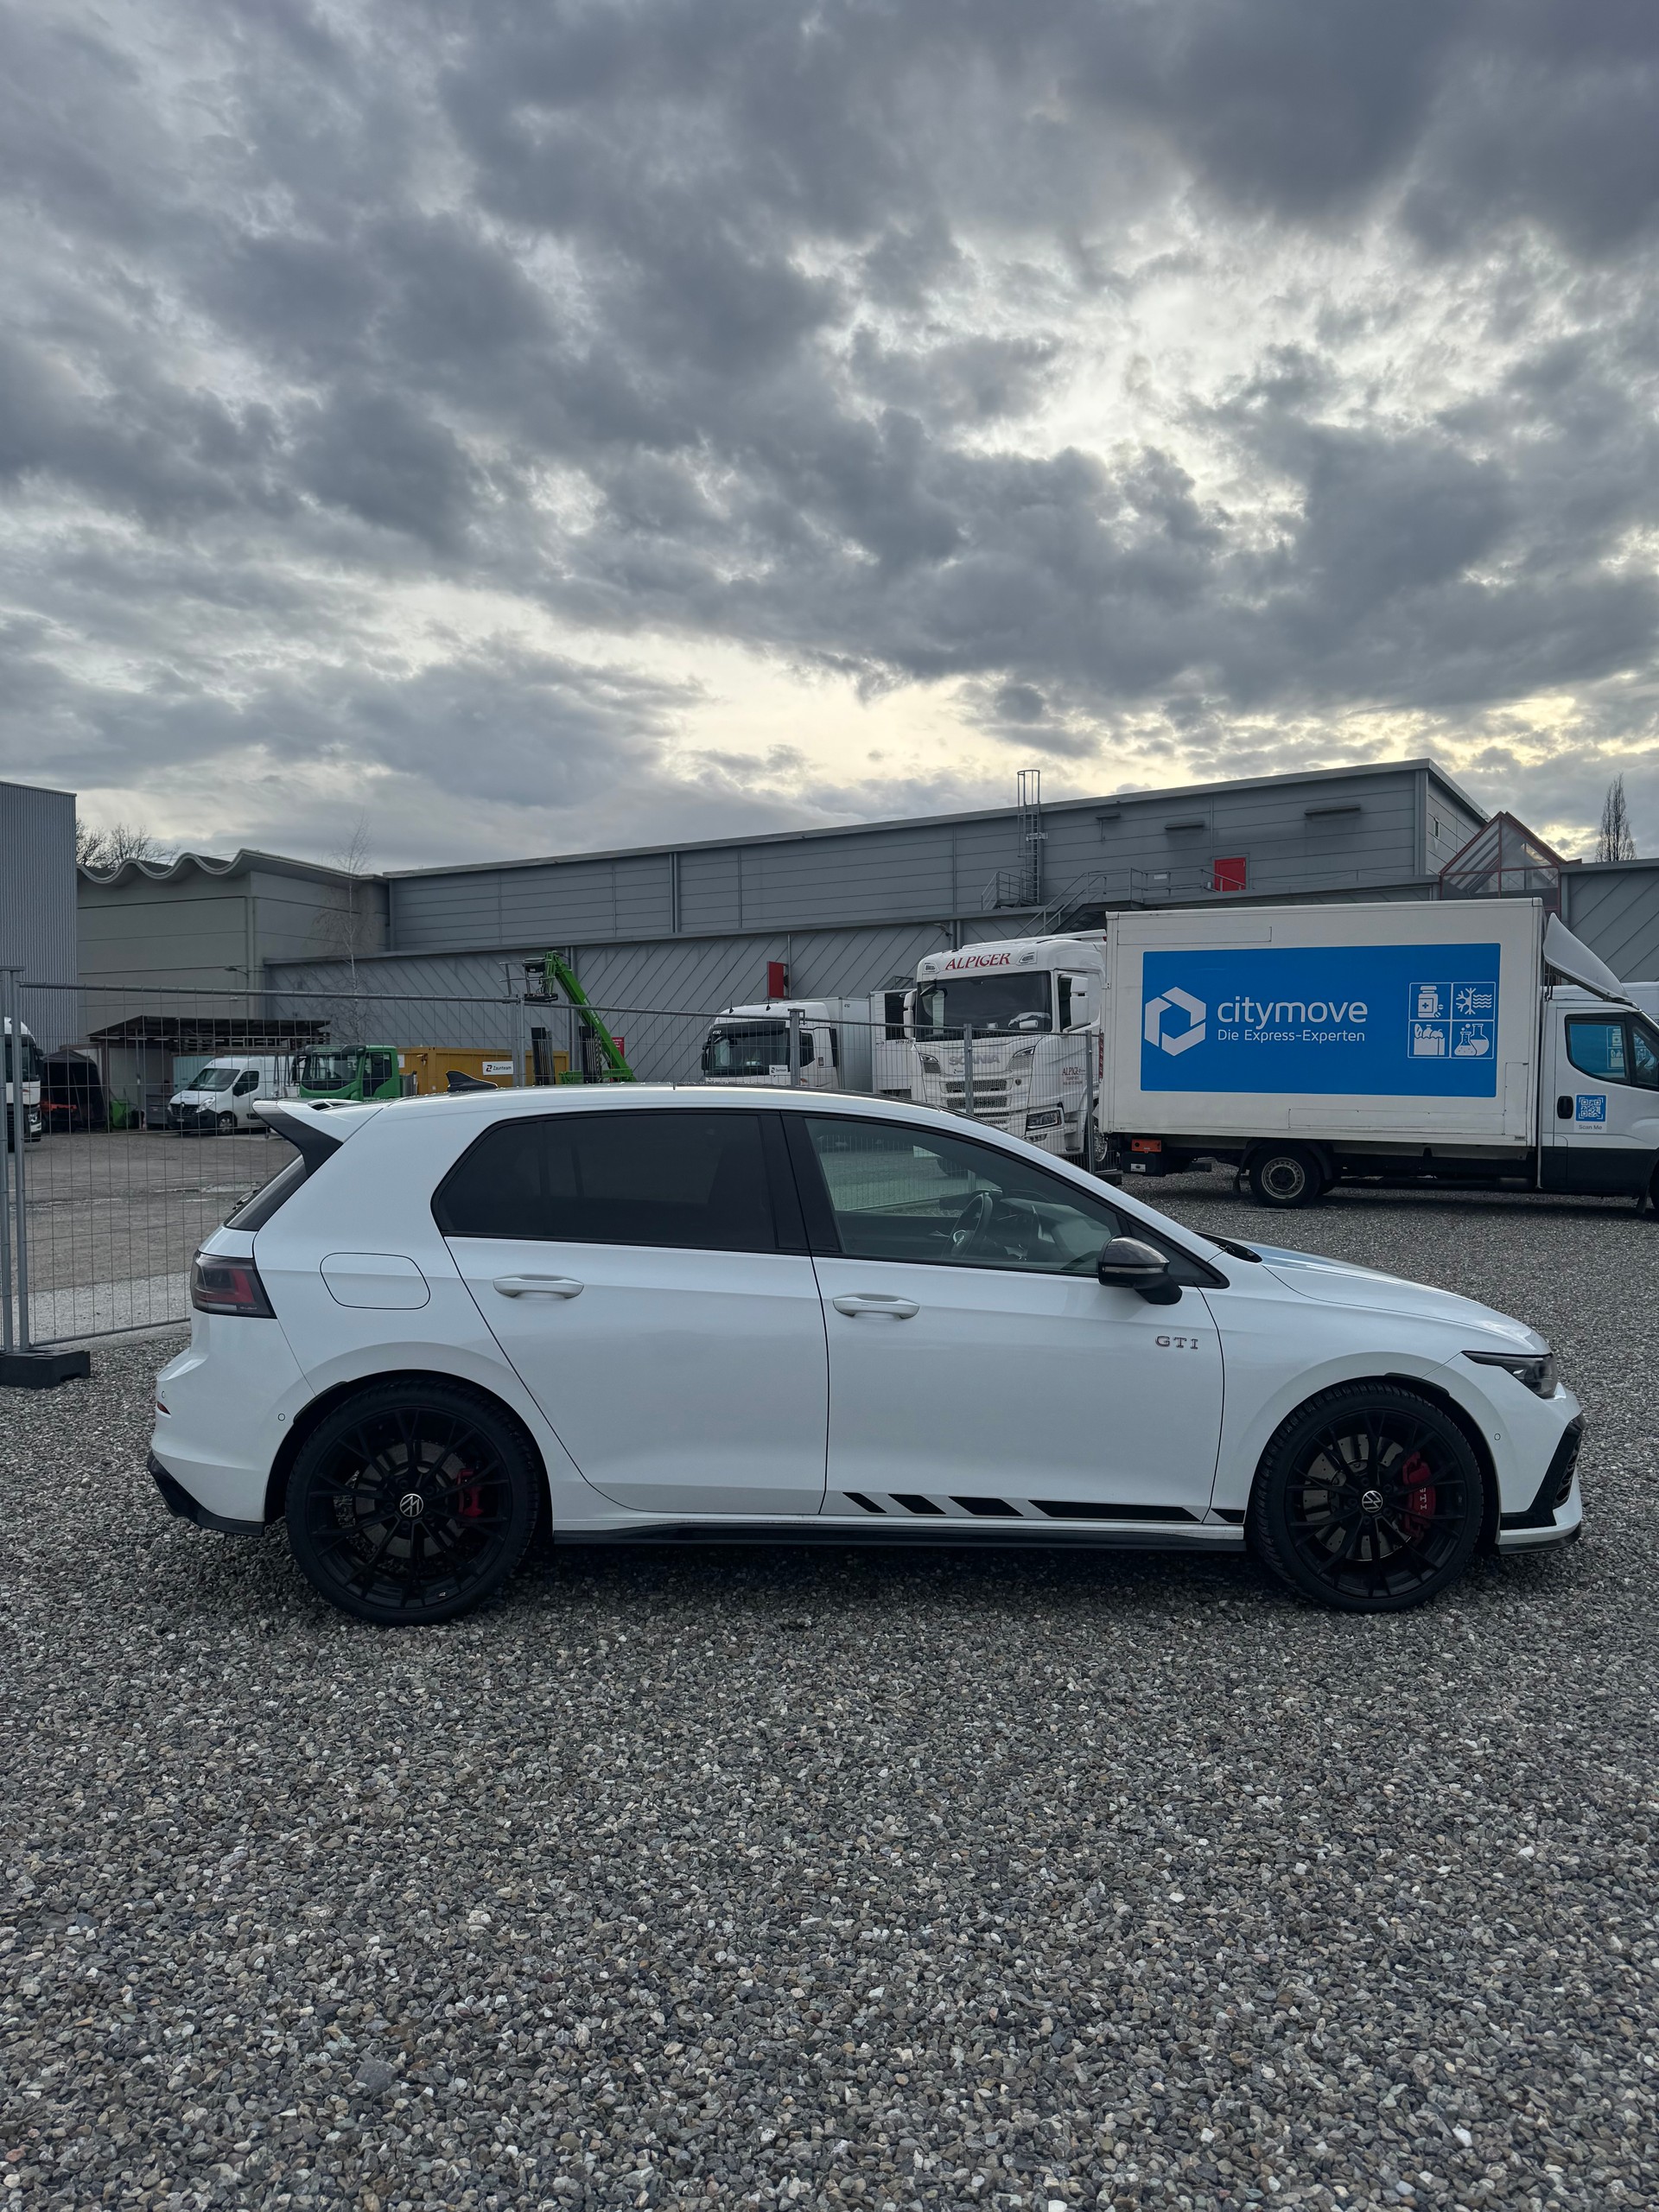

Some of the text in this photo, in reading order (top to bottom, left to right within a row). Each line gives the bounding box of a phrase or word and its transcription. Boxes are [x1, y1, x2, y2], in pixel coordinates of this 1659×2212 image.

[944, 952, 1011, 970] ALPIGER
[1217, 995, 1369, 1030] citymove
[1217, 1029, 1365, 1044] Die Express-Experten
[1154, 1335, 1198, 1350] GTI
